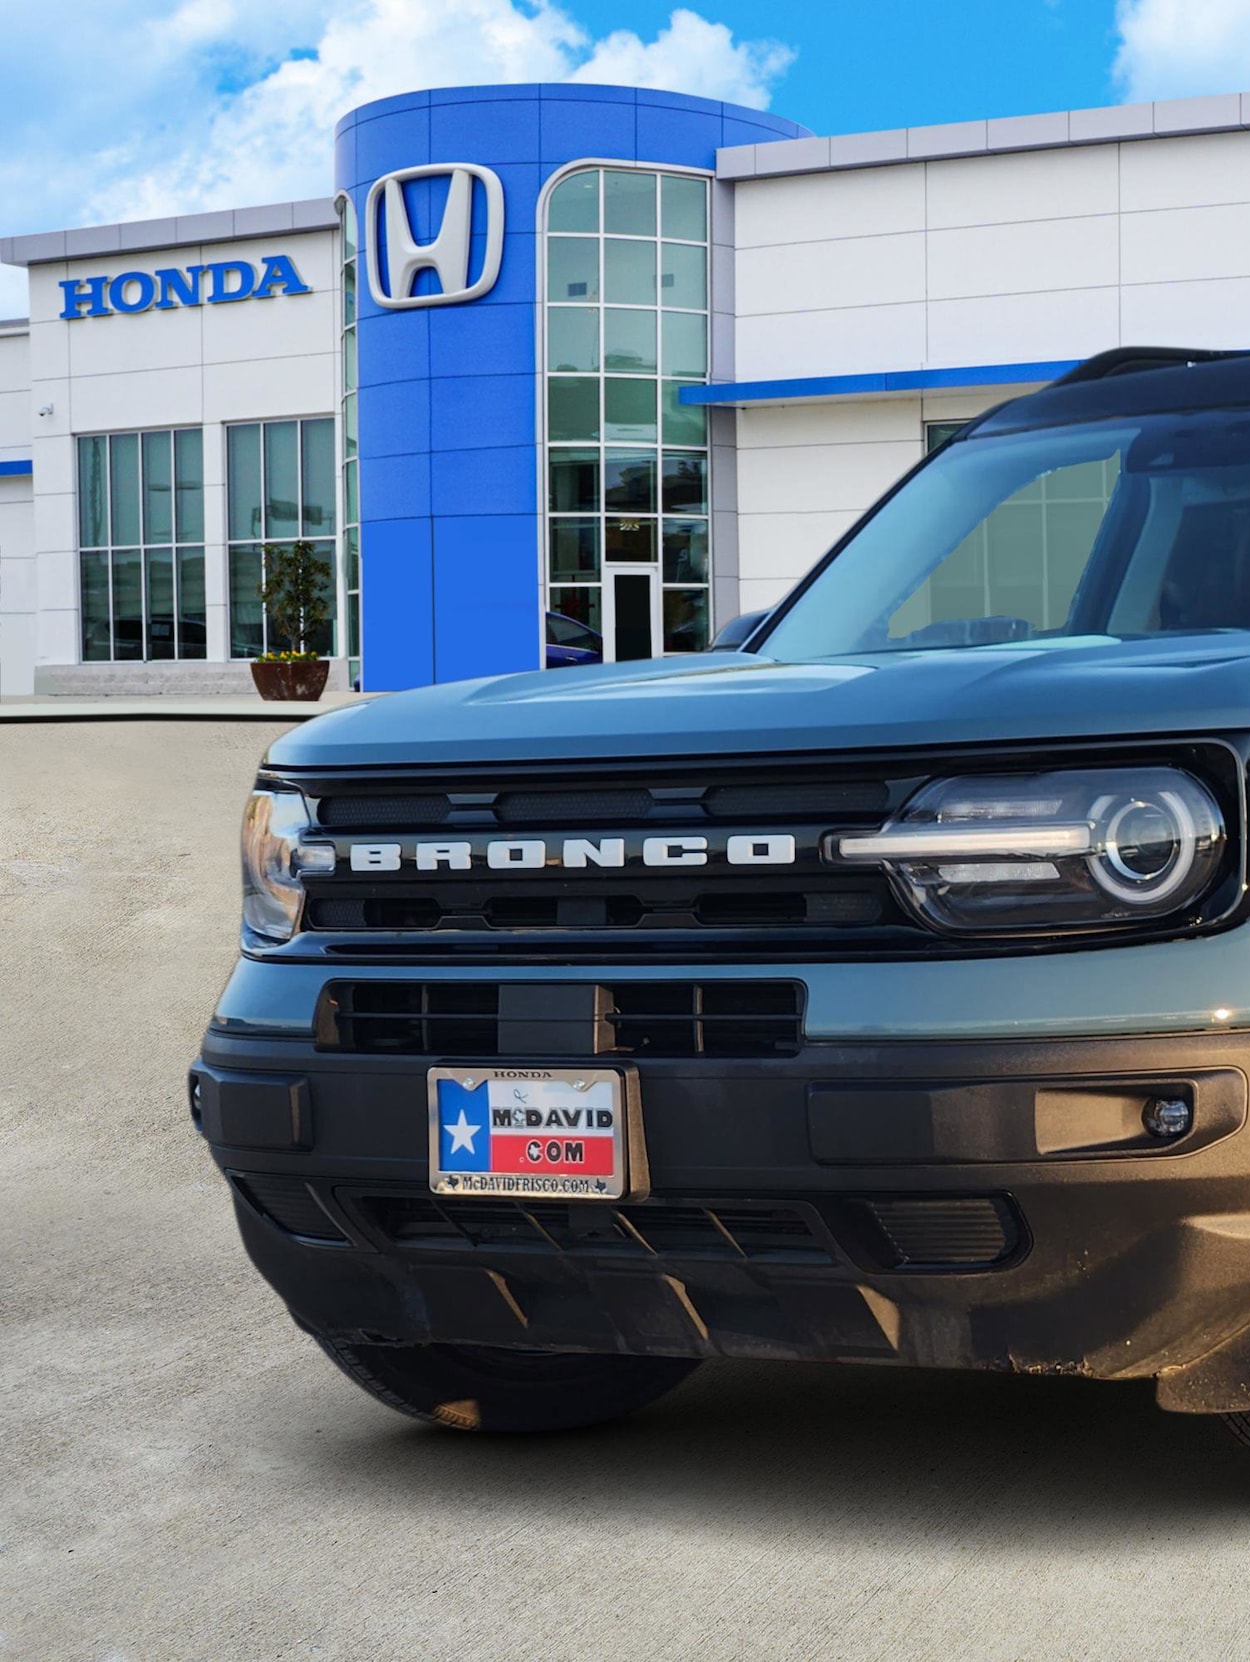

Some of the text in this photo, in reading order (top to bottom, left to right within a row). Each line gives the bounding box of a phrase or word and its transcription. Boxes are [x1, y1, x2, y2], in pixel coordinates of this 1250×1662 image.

[58, 254, 312, 320] HONDA
[350, 834, 796, 872] BRONCO
[493, 1070, 553, 1079] HONDA
